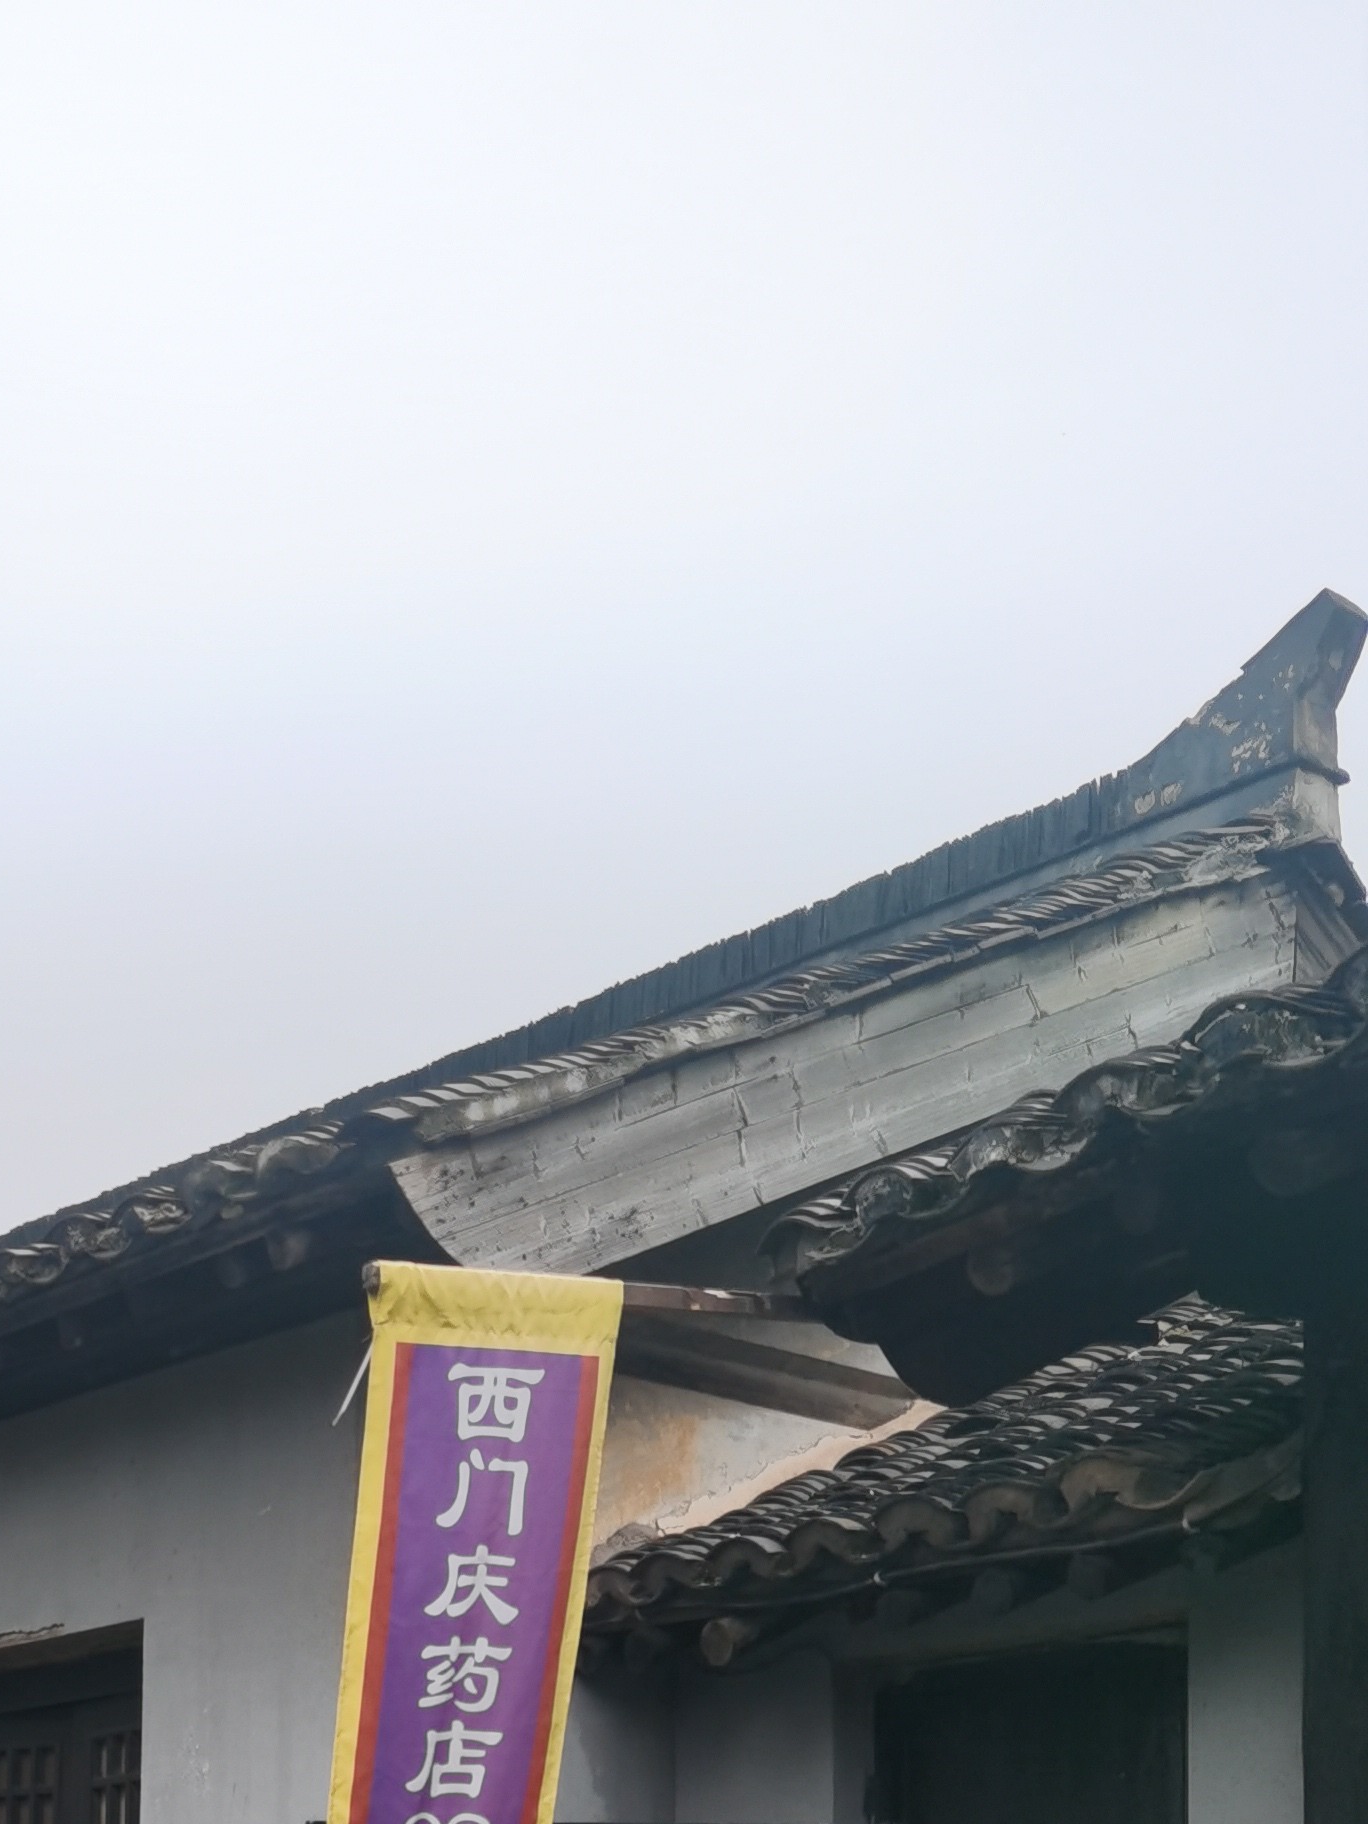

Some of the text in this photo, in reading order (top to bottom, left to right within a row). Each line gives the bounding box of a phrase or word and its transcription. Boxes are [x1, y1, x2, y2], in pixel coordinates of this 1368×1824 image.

[406, 1363, 545, 1799] 西门庆药店
